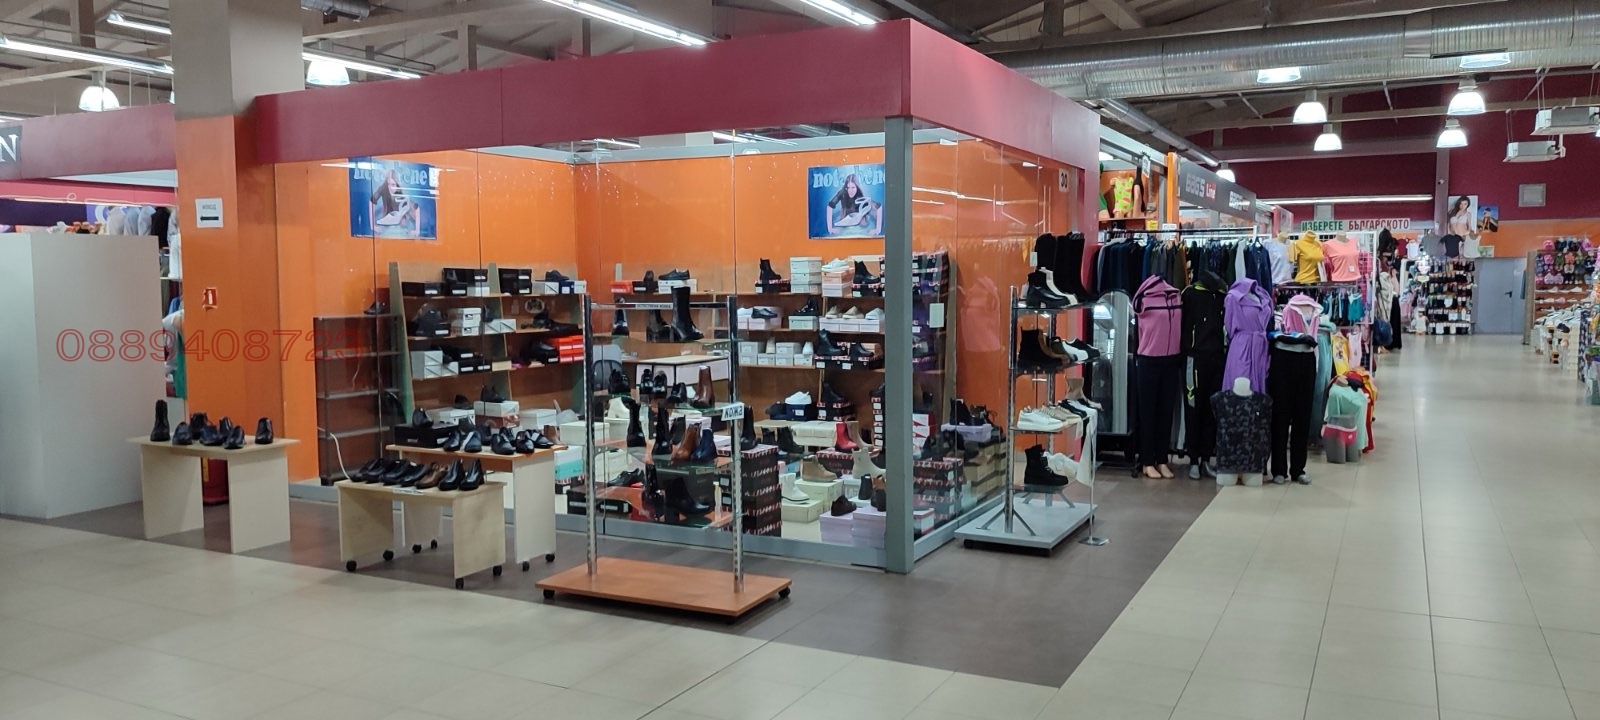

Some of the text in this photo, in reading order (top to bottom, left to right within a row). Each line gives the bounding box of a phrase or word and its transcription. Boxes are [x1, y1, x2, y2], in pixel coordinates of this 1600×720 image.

[853, 165, 886, 186] ben
[1061, 172, 1068, 188] 30
[1302, 219, 1409, 231] ИЗБЕРЕТЕ БЪЛГАРСКОТО
